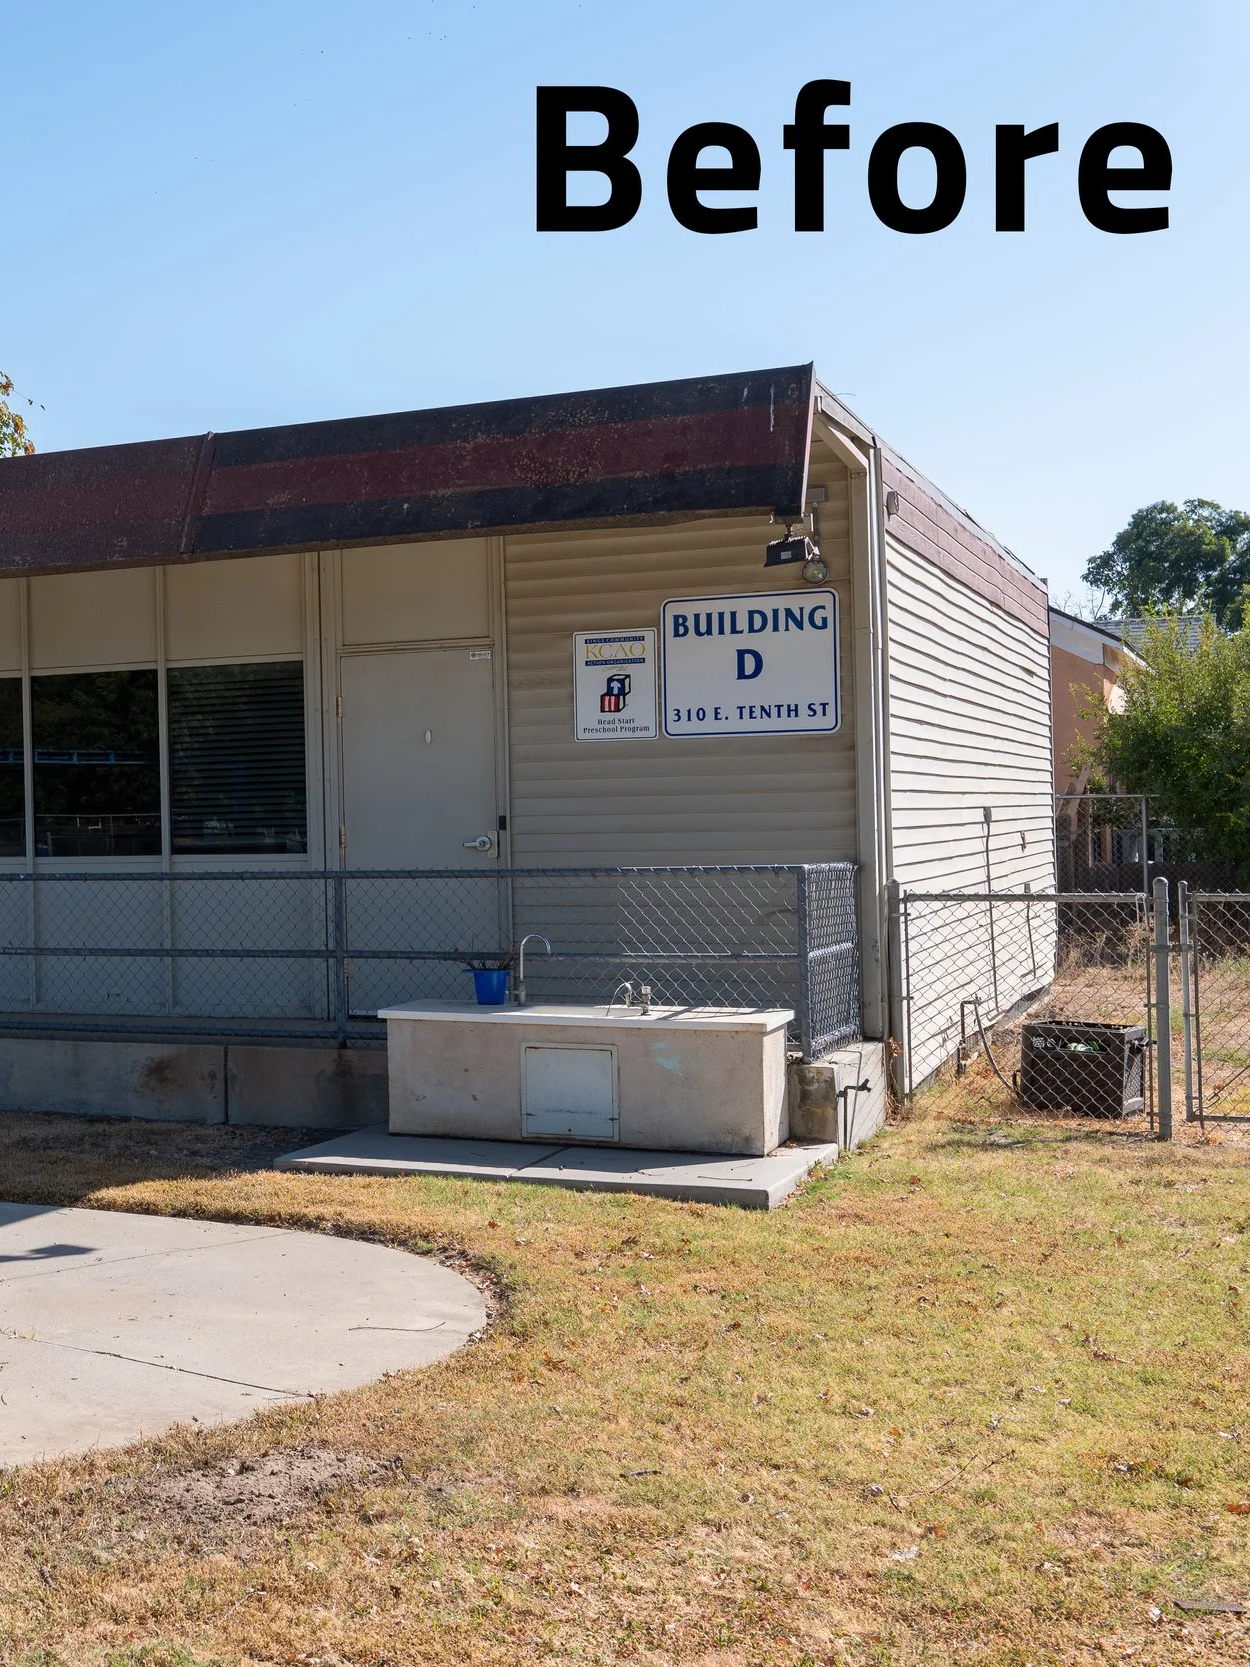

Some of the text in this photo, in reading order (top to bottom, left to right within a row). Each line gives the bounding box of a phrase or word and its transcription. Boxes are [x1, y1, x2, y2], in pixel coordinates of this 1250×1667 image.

[672, 605, 829, 638] BUILDING
[585, 642, 646, 659] KCAO
[736, 648, 764, 681] D
[617, 717, 635, 725] Start
[673, 702, 830, 723] 310 E. TENTH ST
[583, 725, 650, 734] Preschool Program
